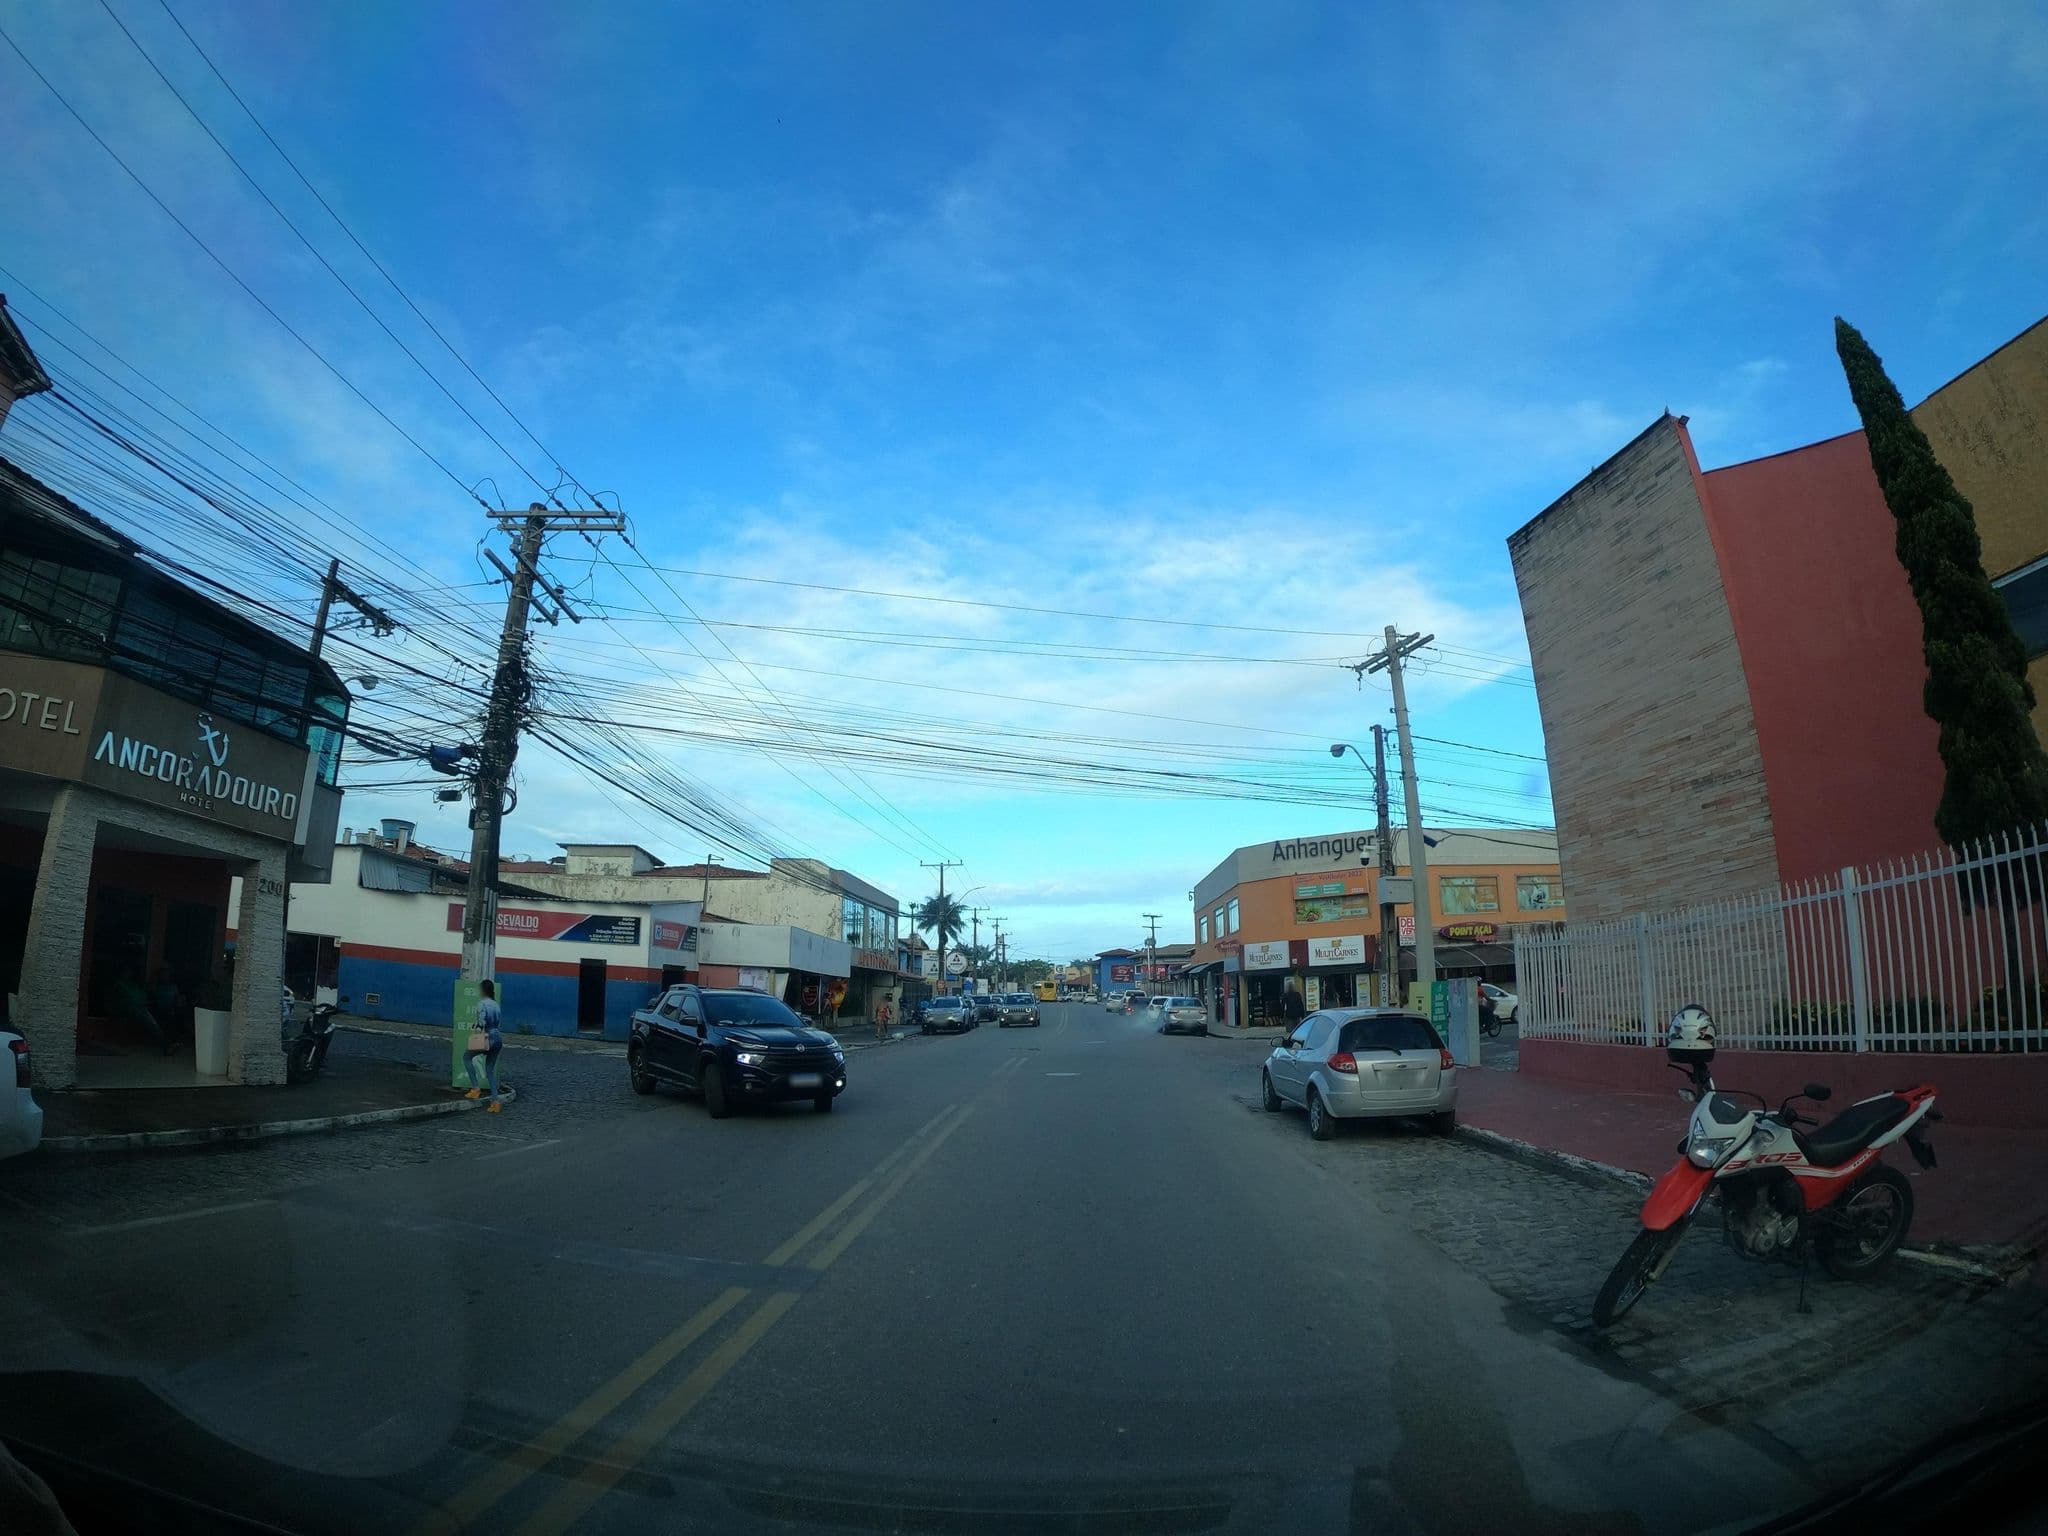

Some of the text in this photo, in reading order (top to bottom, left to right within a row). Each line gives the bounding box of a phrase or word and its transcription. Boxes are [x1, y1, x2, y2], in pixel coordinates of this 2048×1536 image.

[94, 731, 297, 820] ANCORADOURO
[180, 792, 216, 811] HOTEL
[1272, 834, 1378, 861] Anhanguer
[497, 913, 539, 928] SEVALDO
[1401, 918, 1415, 927] DEL
